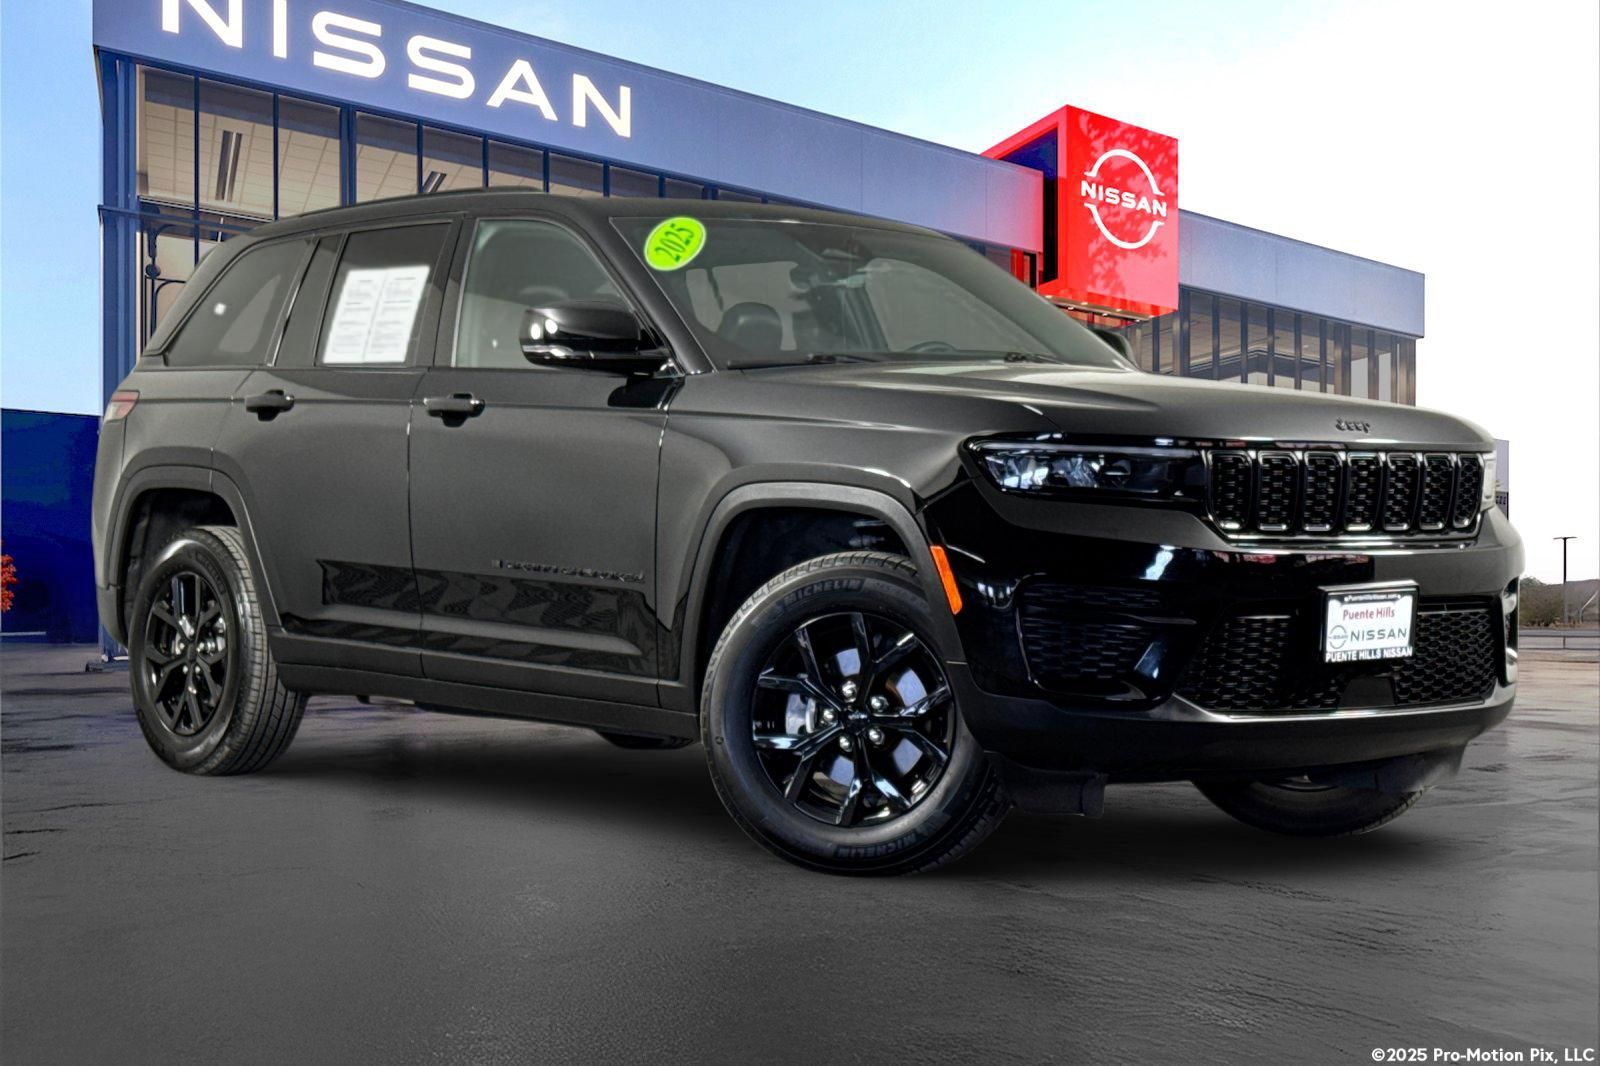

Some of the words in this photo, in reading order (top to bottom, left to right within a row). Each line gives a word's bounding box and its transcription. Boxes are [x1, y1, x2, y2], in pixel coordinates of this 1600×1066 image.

[161, 0, 632, 139] NISSAN
[1080, 180, 1167, 217] NISSAN
[655, 223, 694, 262] 2025
[1335, 417, 1370, 434] Jeep
[784, 577, 864, 604] MICHELIN
[1343, 609, 1374, 620] Puente
[1376, 607, 1395, 618] Hills
[1350, 628, 1407, 641] NISSAN
[1325, 652, 1357, 662] PUENTE
[1359, 649, 1381, 660] HILLS
[1383, 647, 1412, 658] NISSAN
